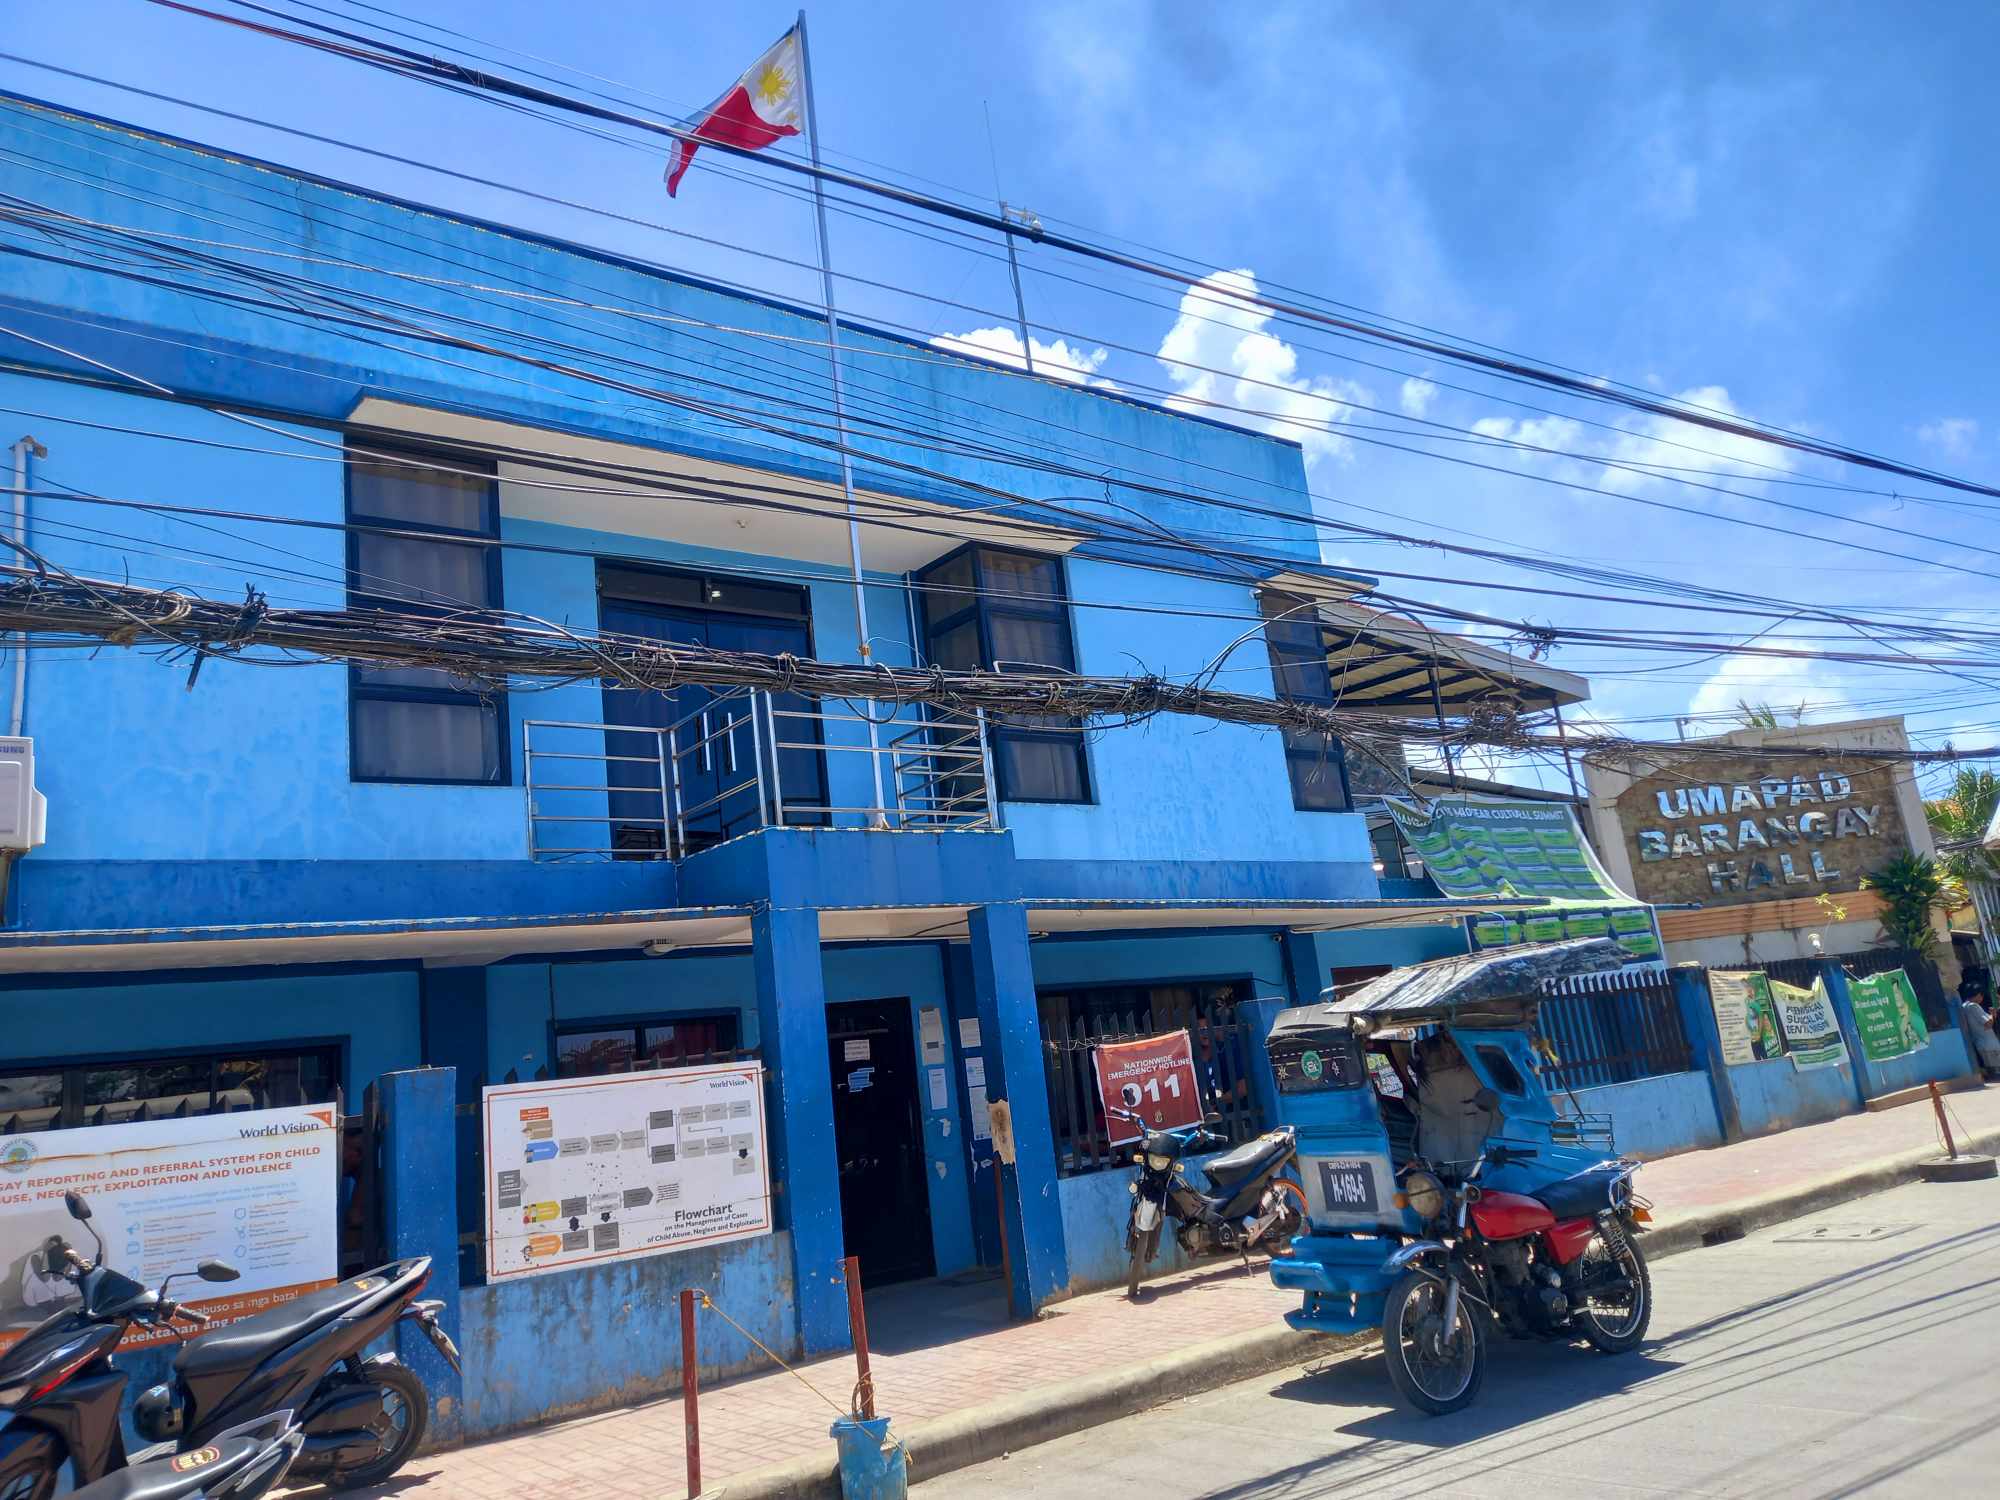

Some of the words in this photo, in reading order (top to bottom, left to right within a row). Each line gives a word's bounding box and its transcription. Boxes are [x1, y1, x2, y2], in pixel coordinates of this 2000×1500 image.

[1656, 768, 1852, 820] UMAPAD
[1640, 804, 1881, 863] BARANGAY
[1707, 848, 1841, 893] HALL
[1107, 1064, 1158, 1080] EMERGENCY
[1123, 1054, 1173, 1070] NATIONWIDE
[709, 1080, 728, 1089] World
[728, 1079, 747, 1087] Vision
[239, 1124, 278, 1138] World
[281, 1122, 319, 1134] Vision
[27, 1171, 105, 1188] REPORTING
[111, 1168, 139, 1178] AND
[143, 1160, 206, 1175] REFERRAL
[209, 1154, 255, 1167] SYSTEM
[258, 1151, 282, 1161] FOR
[285, 1146, 321, 1158] CHILD
[0, 1193, 33, 1204] USE,
[36, 1184, 101, 1200] NEGECT,
[104, 1172, 199, 1192] EXPLOITATION
[202, 1168, 230, 1180] AND
[234, 1161, 293, 1176] VIOLENCE
[1330, 1173, 1367, 1203] H-169-6
[674, 1203, 734, 1222] Flowchart
[674, 1222, 685, 1230] the
[685, 1216, 723, 1230] Management
[731, 1212, 748, 1221] Cases
[655, 1232, 671, 1243] Child
[672, 1229, 693, 1240] Abuse,
[693, 1225, 717, 1238] Neglect
[717, 1222, 729, 1231] and
[729, 1217, 764, 1231] Exploitation
[192, 1302, 230, 1315] abuso
[119, 1323, 198, 1345] otektahan
